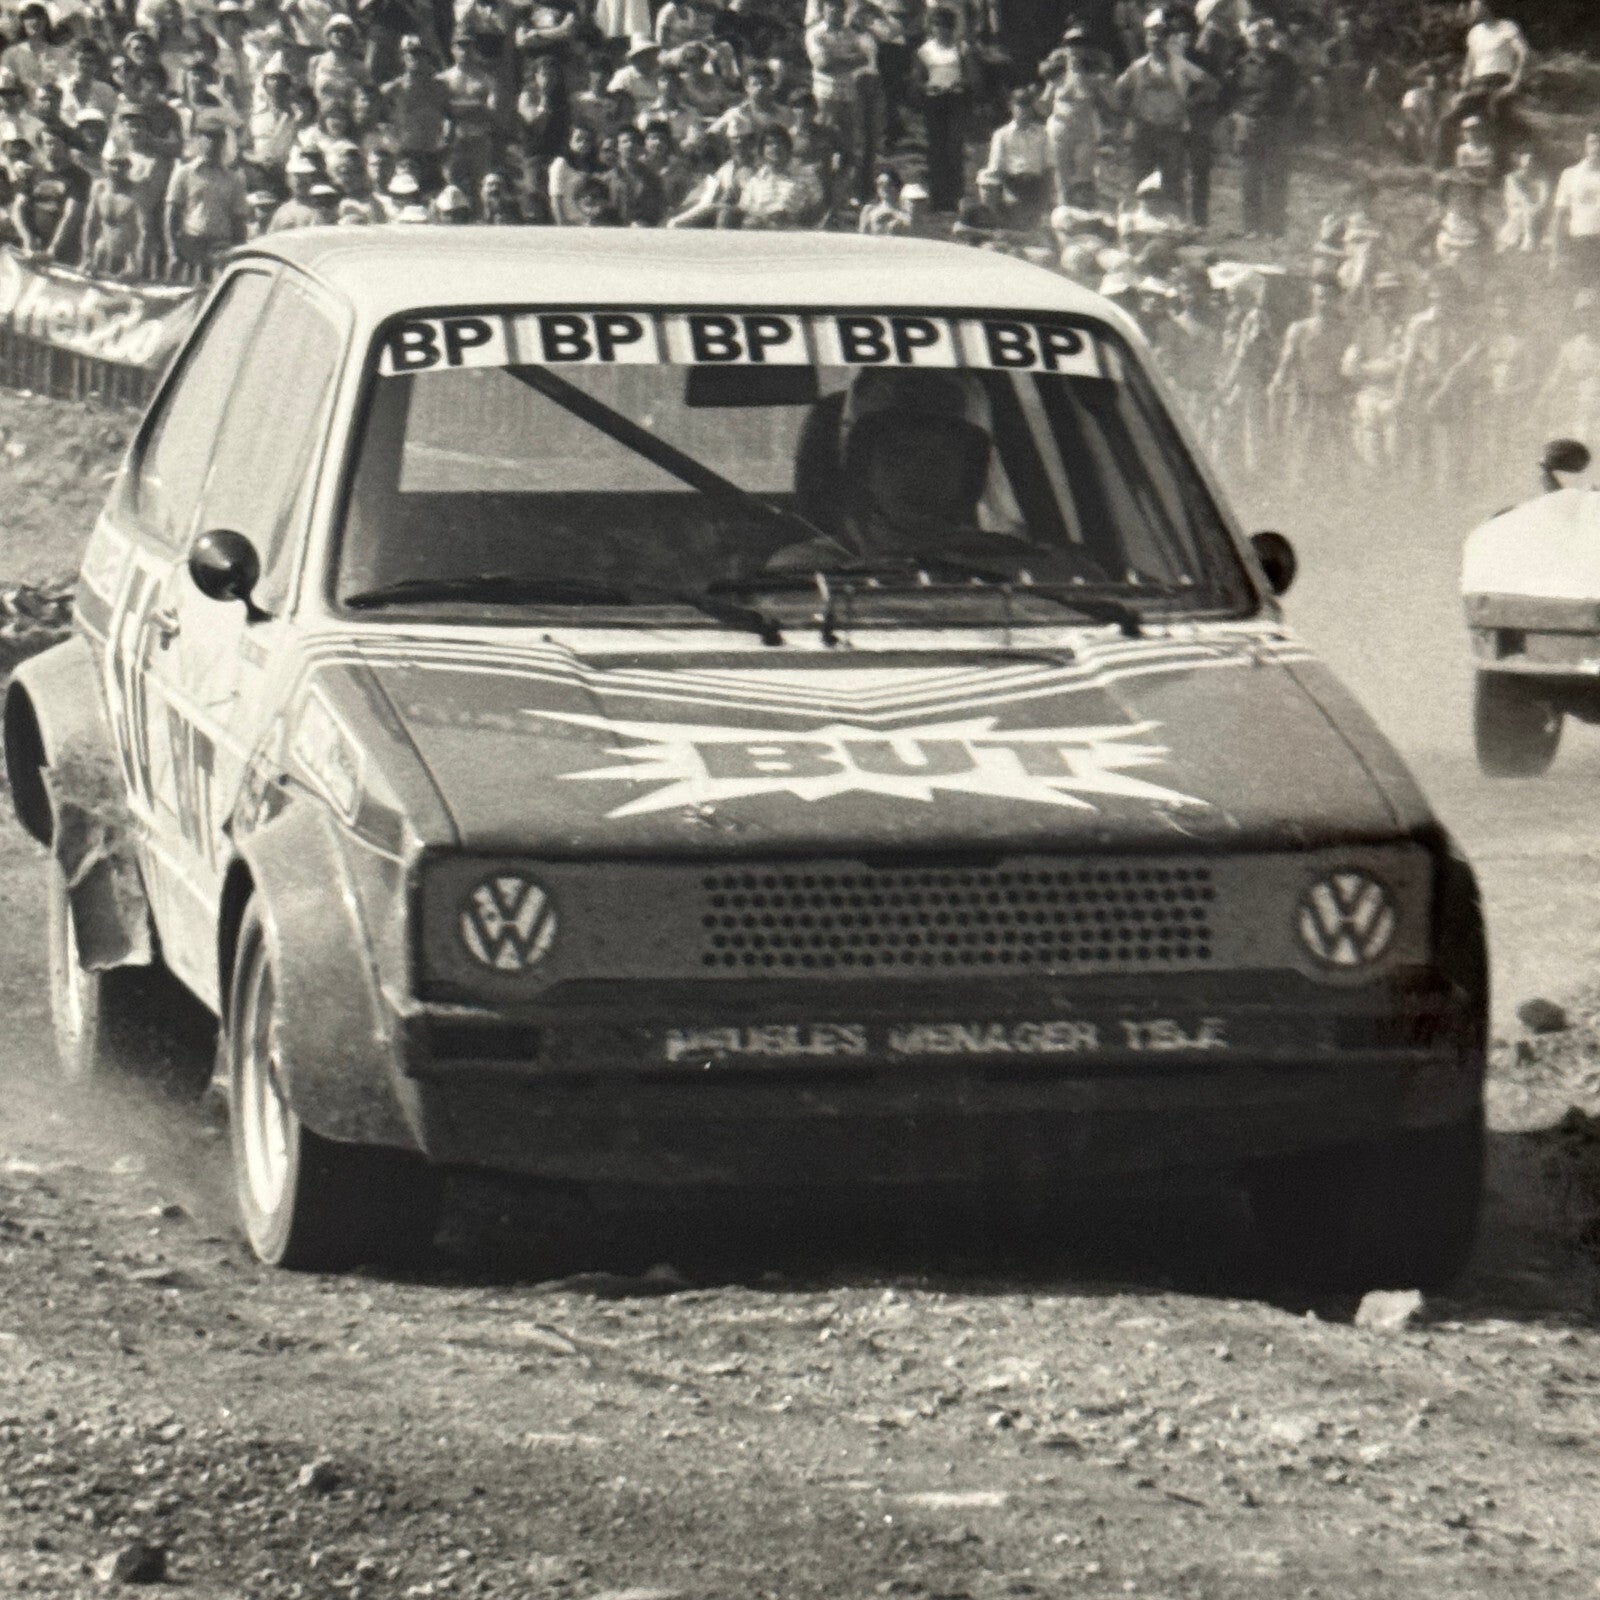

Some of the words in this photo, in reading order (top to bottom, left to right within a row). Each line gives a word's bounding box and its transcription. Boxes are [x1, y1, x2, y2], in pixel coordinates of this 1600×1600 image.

[391, 318, 492, 371] BP
[537, 314, 643, 362] BP
[688, 315, 793, 363] BP
[835, 316, 939, 364] BP
[983, 321, 1084, 370] BP
[691, 739, 1091, 778] BUT
[459, 875, 557, 971] VW
[1300, 873, 1395, 966] VW
